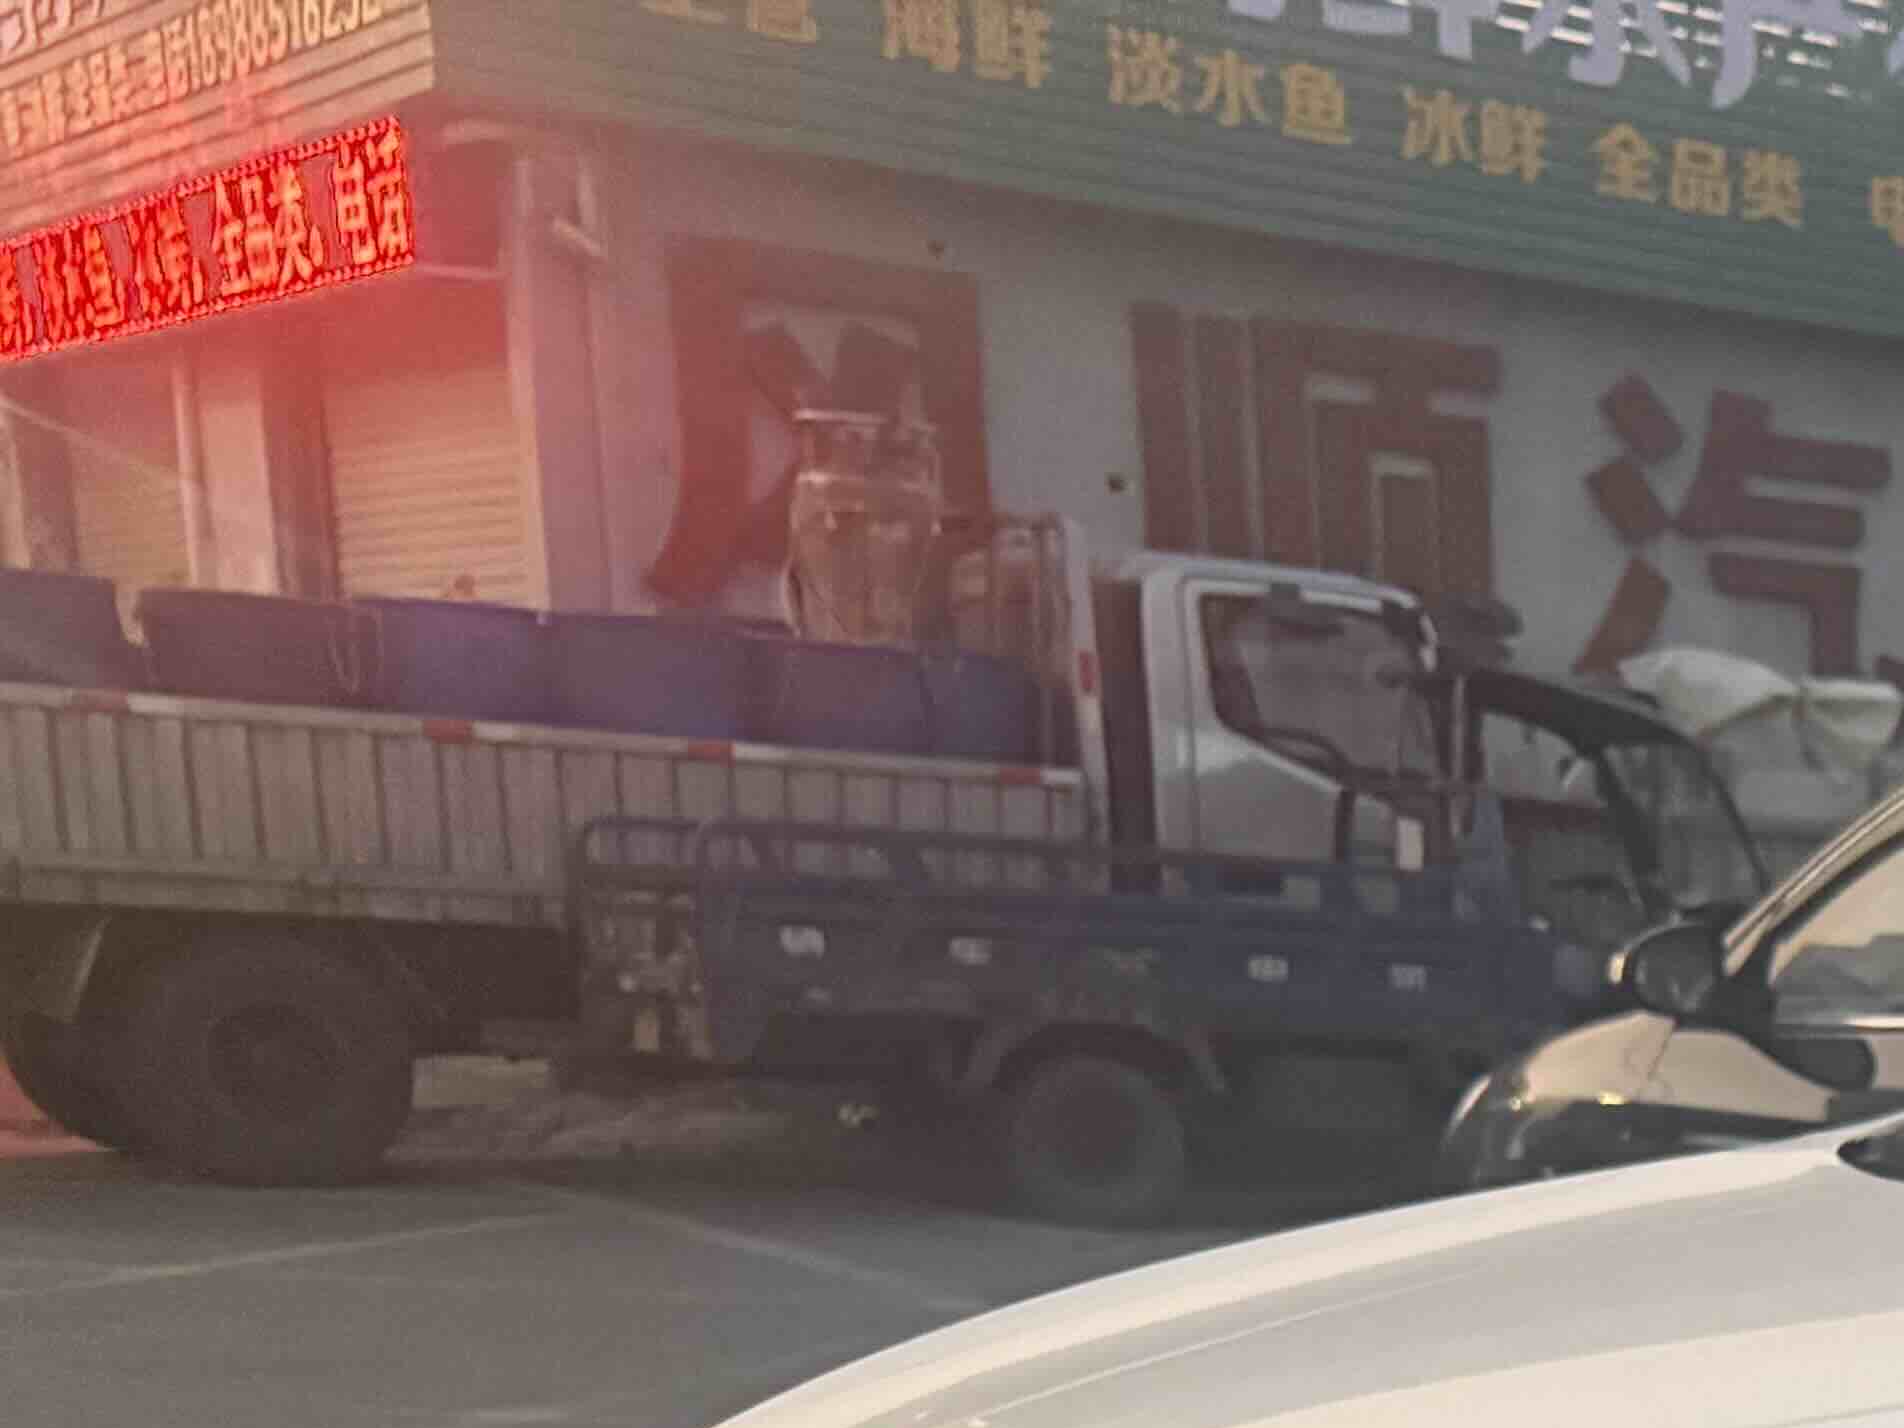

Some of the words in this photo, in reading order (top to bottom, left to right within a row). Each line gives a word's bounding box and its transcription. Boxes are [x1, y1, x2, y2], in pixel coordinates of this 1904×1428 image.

[1107, 24, 1352, 145] 淡水鱼
[1403, 84, 1549, 183] 冰鲜
[1594, 121, 1804, 228] 全品类
